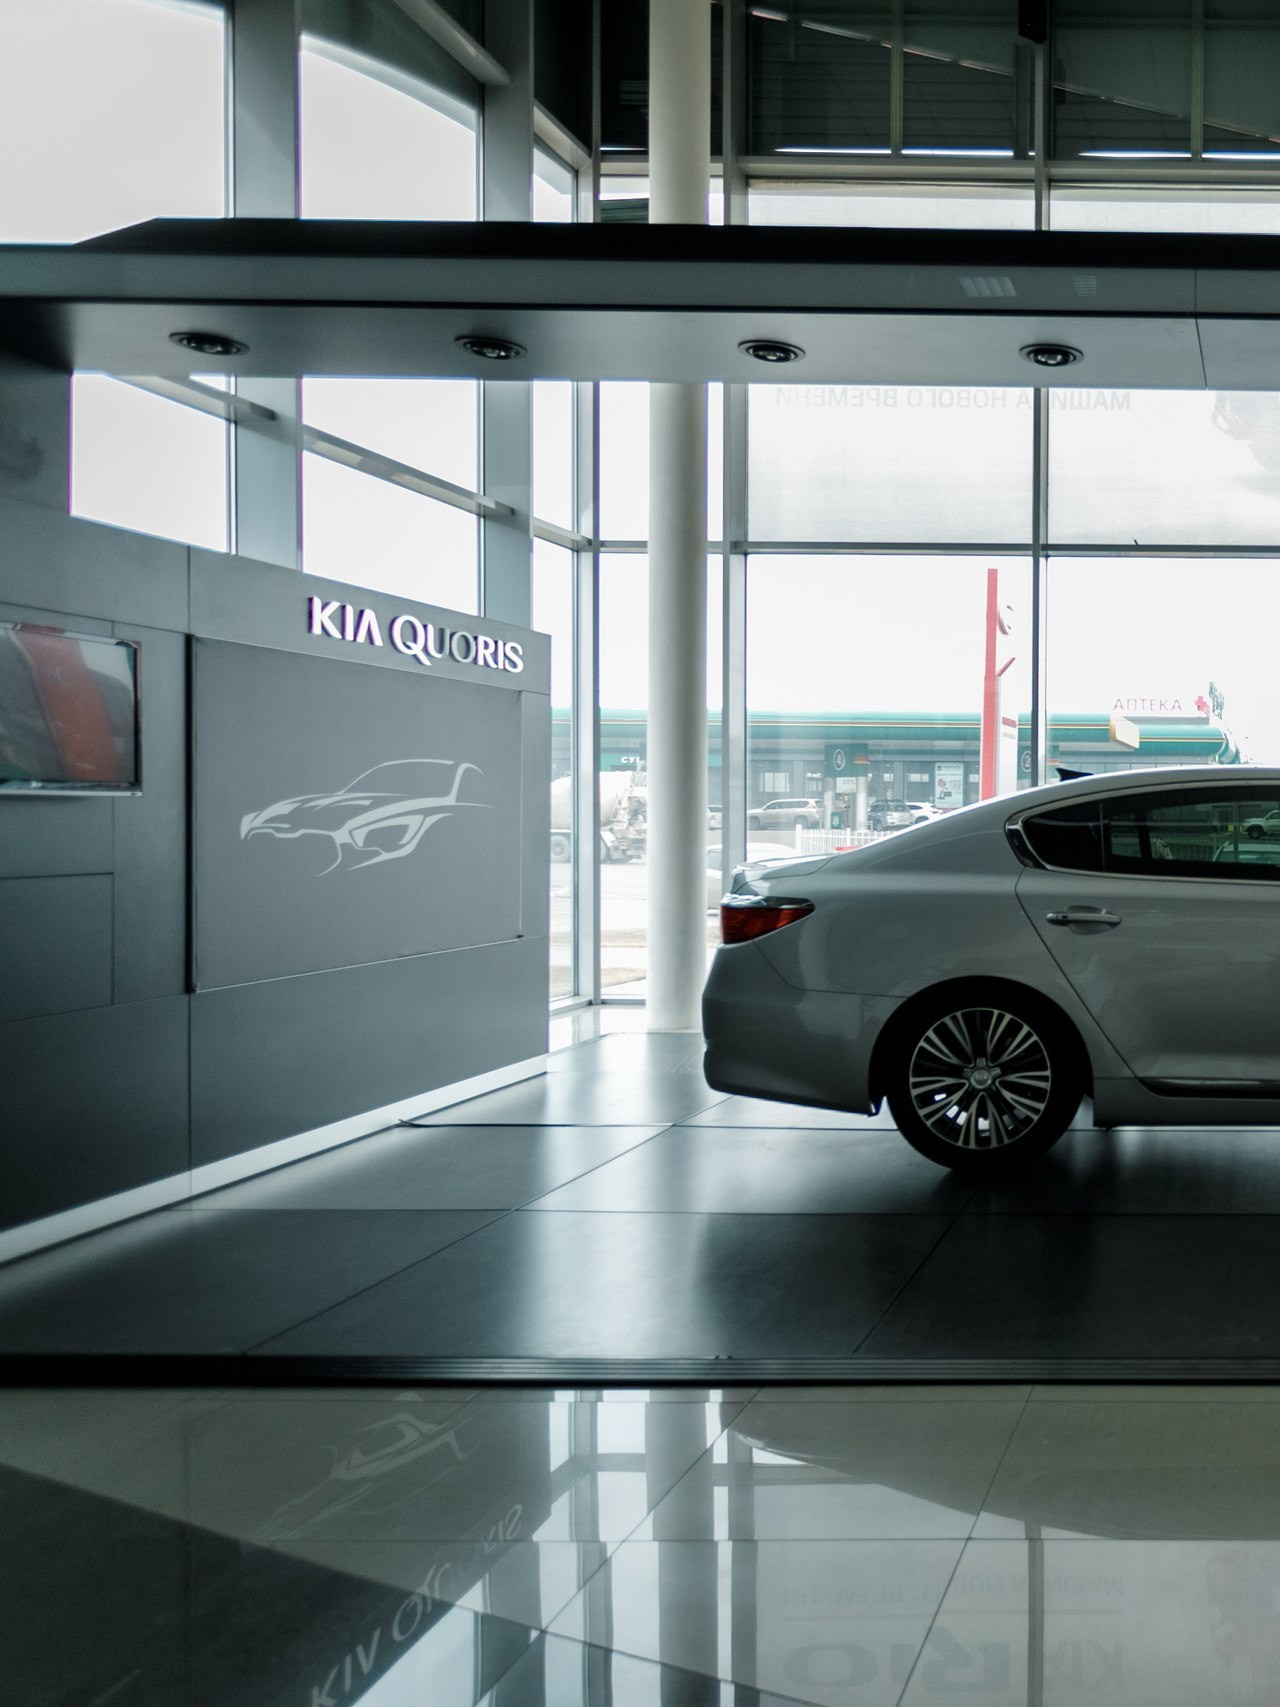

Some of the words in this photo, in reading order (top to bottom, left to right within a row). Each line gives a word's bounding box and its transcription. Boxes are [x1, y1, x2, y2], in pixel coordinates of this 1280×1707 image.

[309, 596, 383, 647] KIA
[390, 614, 524, 674] QUORIS
[1113, 698, 1182, 713] АПТЕКА
